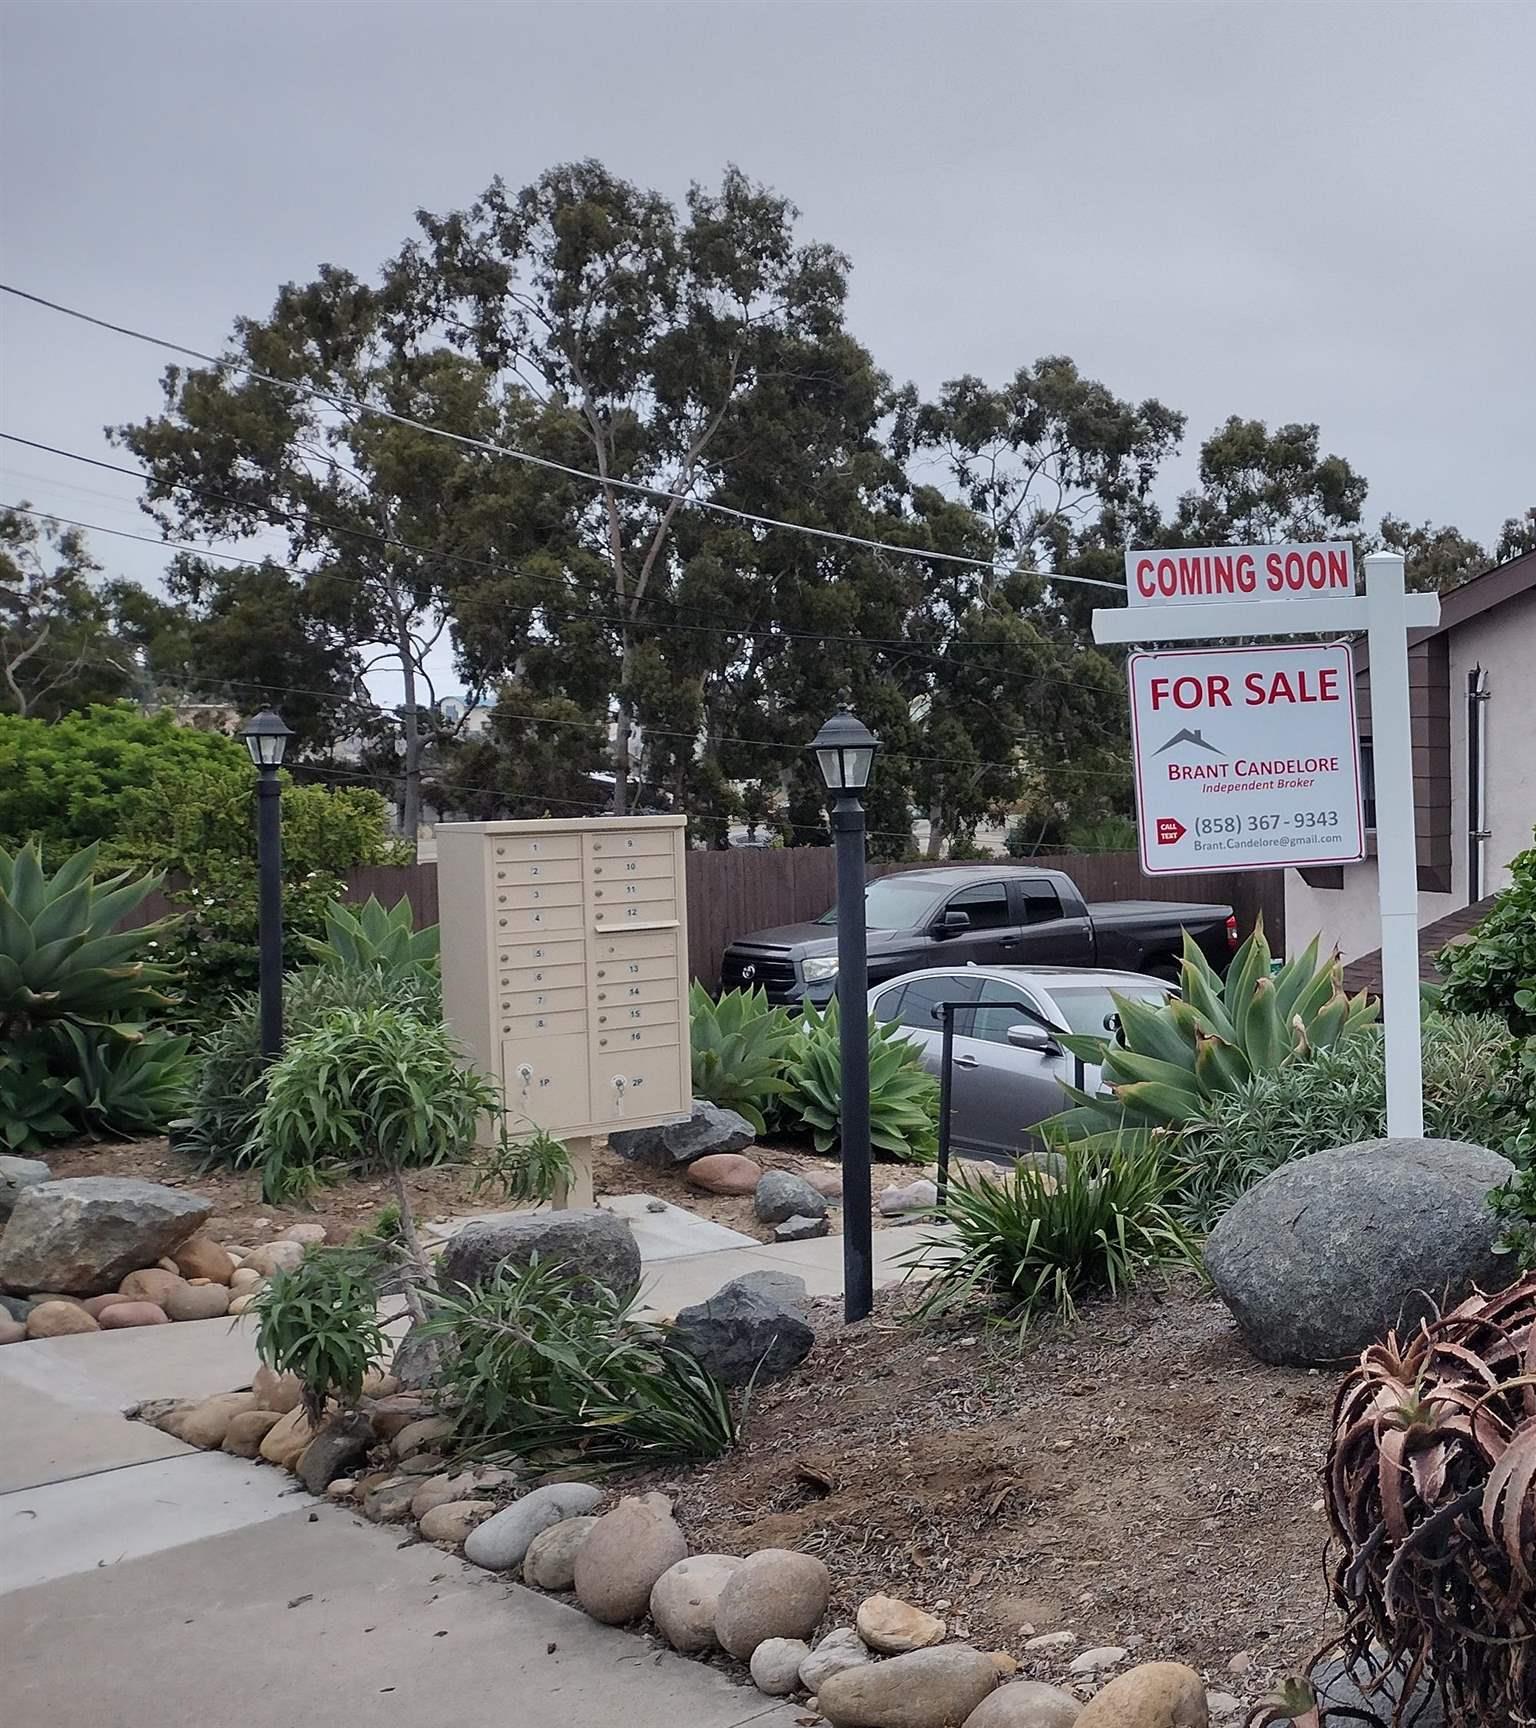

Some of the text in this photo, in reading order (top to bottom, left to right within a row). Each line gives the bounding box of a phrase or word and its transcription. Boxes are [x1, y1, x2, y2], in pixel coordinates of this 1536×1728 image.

[1136, 550, 1349, 598] COMING SOON
[1150, 669, 1340, 711] FOR SALE
[1167, 757, 1340, 781] BRANT CANDELORE
[1202, 777, 1316, 795] Independent Broker
[1160, 823, 1178, 831] CALL
[1194, 815, 1242, 837] (858)
[1160, 832, 1178, 840] TEXT
[1193, 834, 1342, 851] Brant.Candelore@gmail.com
[626, 862, 636, 871] 10
[626, 885, 636, 893] 11
[627, 908, 638, 917] 12
[629, 964, 639, 973] 13
[629, 988, 640, 996] 14
[630, 1010, 641, 1018] 15
[631, 1032, 641, 1041] 16
[539, 1078, 551, 1088] 1P
[632, 1078, 644, 1088] 2P
